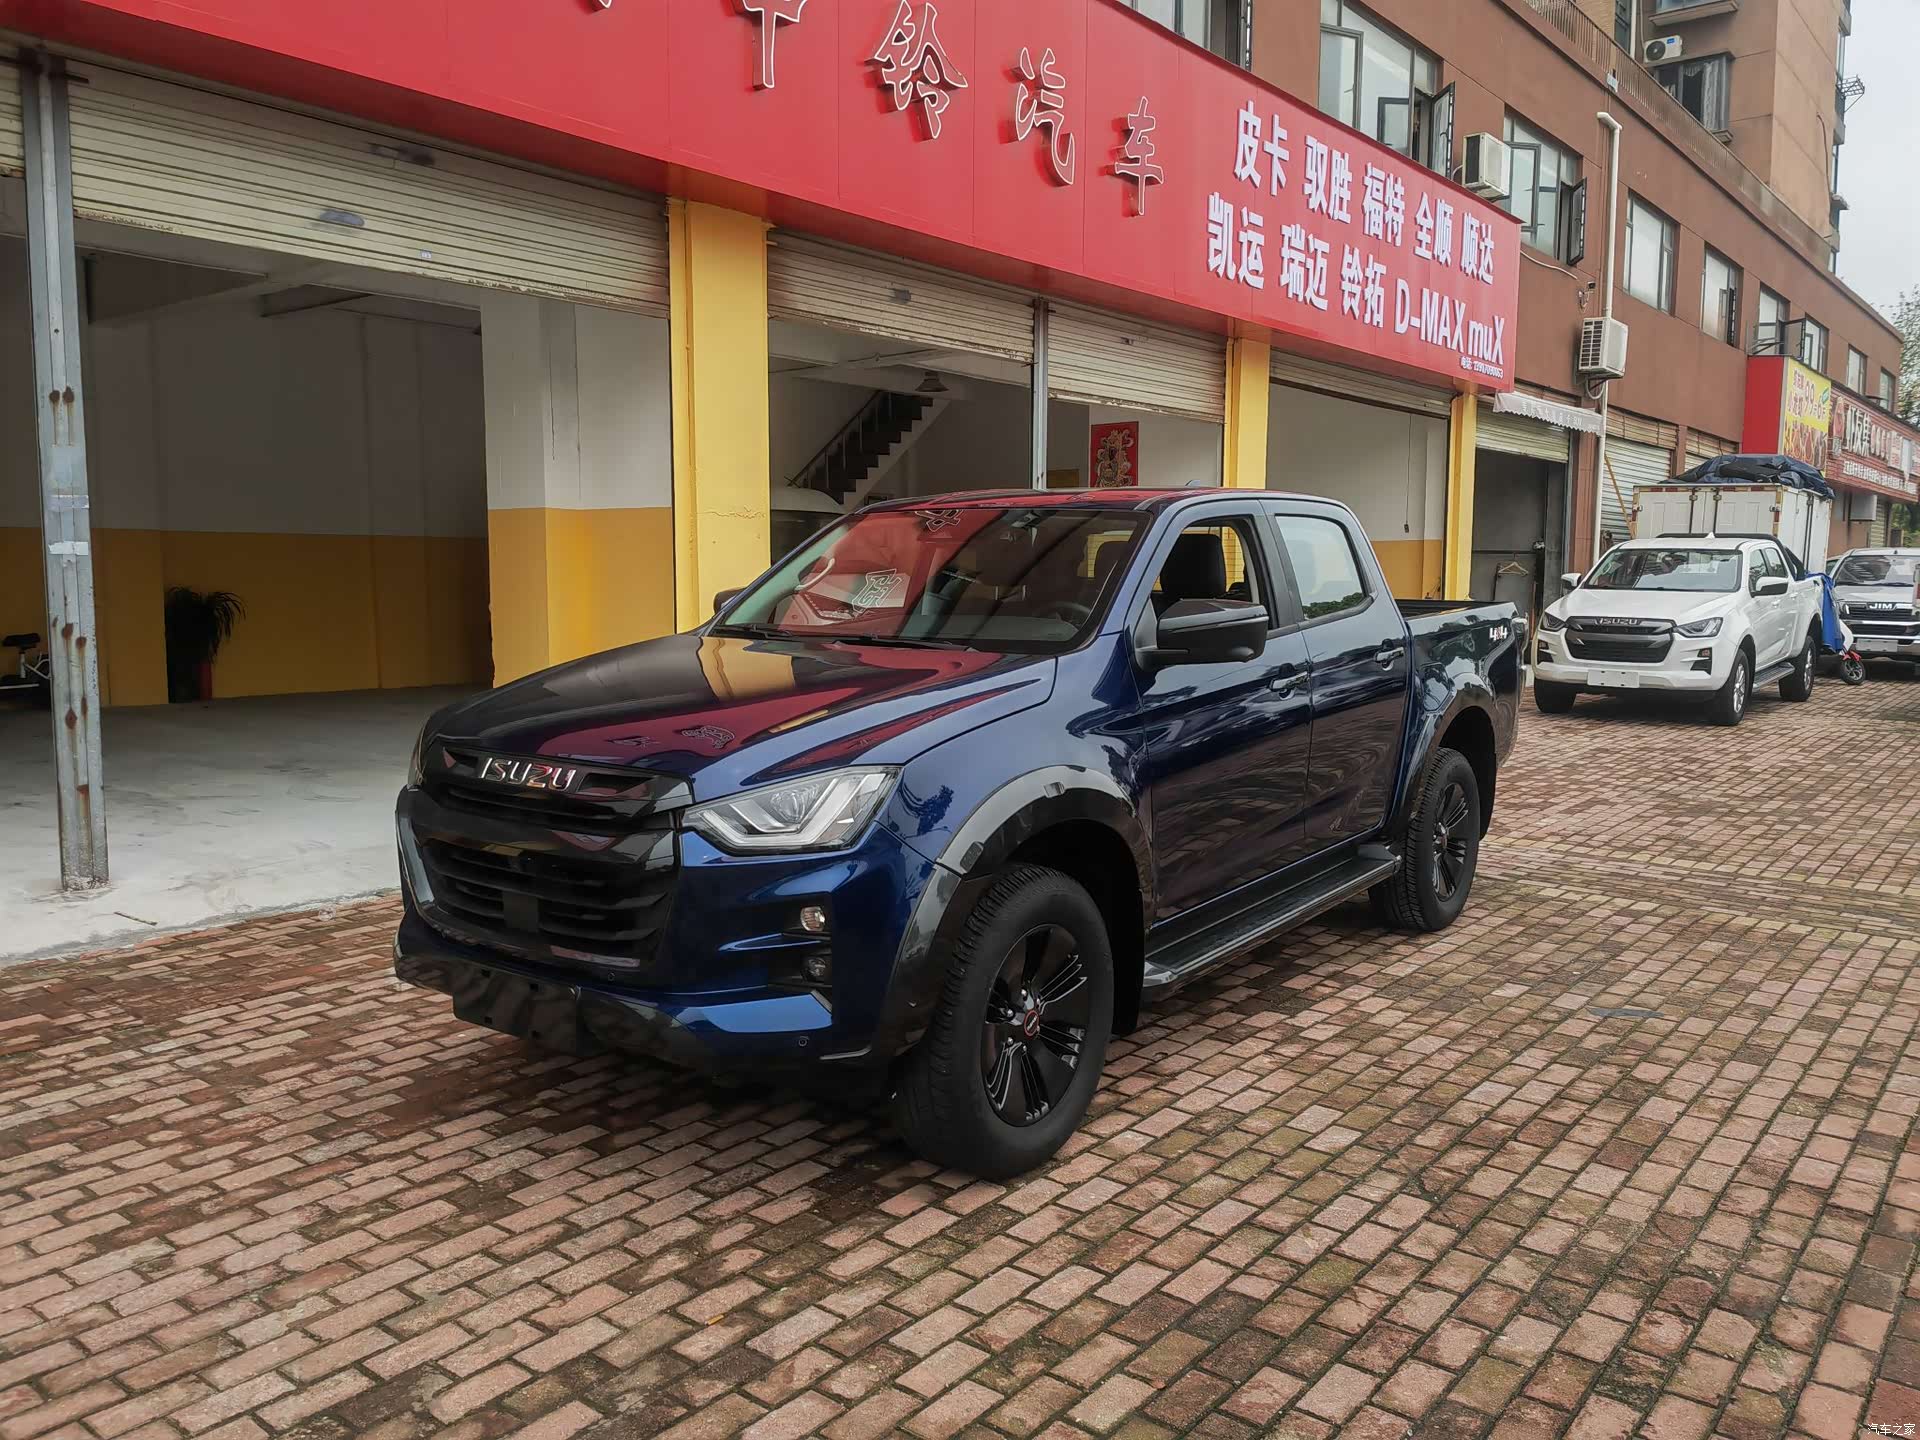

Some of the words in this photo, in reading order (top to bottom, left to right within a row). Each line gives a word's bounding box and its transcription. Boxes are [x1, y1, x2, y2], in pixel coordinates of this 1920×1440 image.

[1207, 191, 1265, 290] 凯运
[1279, 223, 1330, 311] 瑞迈
[1340, 243, 1387, 328] 铃拓
[1394, 277, 1467, 354] D-MAX
[1467, 315, 1505, 366] muX
[1234, 100, 1290, 197] 皮卡
[1303, 134, 1353, 224] 驭胜
[1362, 162, 1405, 248] 福特
[1414, 191, 1454, 267] 全顺
[1461, 211, 1495, 285] 顺达
[480, 757, 577, 792] ISUZU
